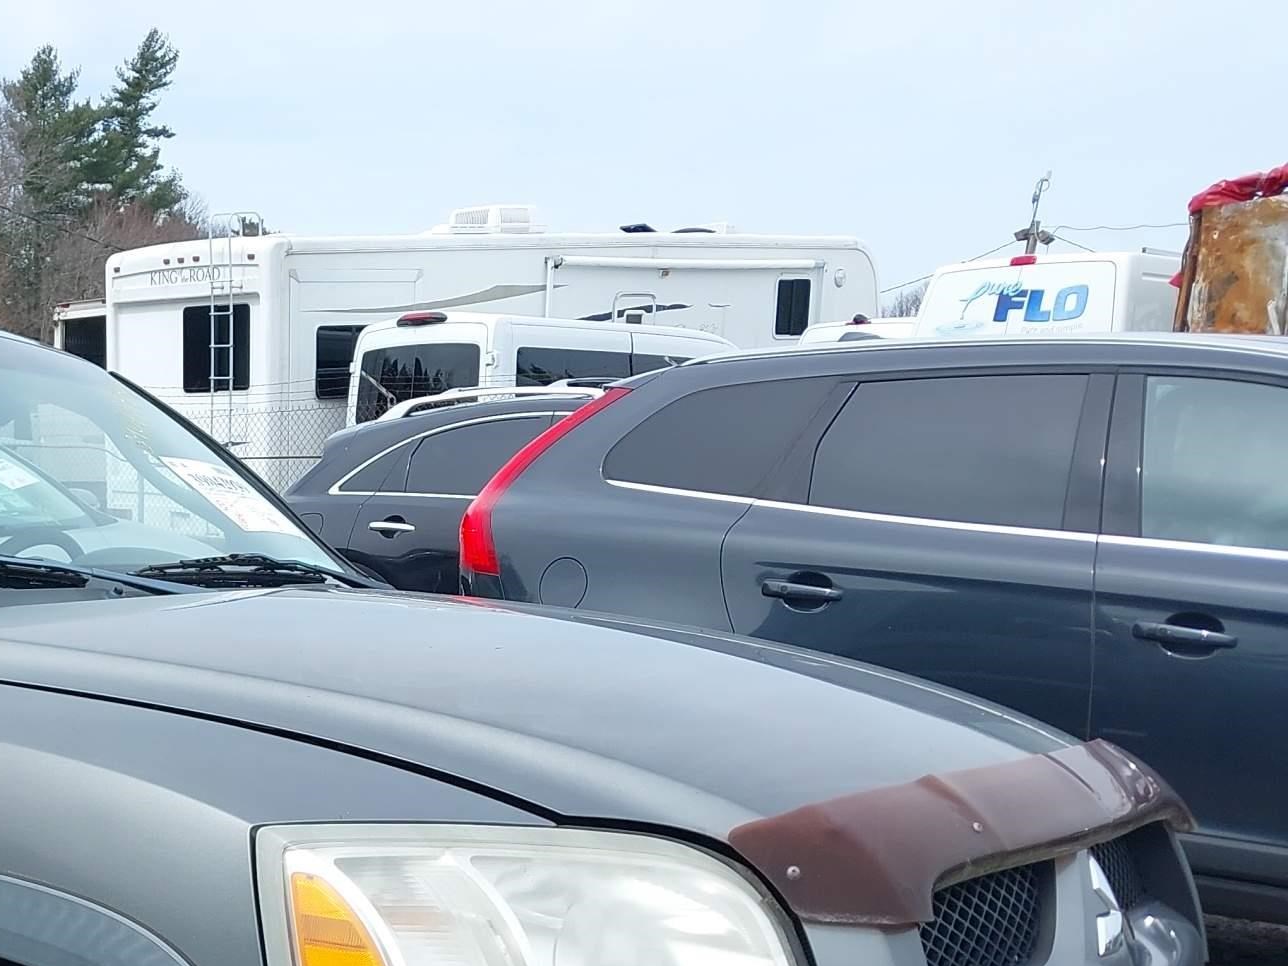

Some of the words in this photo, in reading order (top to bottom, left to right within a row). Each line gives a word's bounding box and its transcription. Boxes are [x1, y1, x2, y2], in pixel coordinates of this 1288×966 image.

[149, 269, 178, 286] KING
[189, 266, 221, 283] ROAD
[993, 284, 1089, 323] FLO
